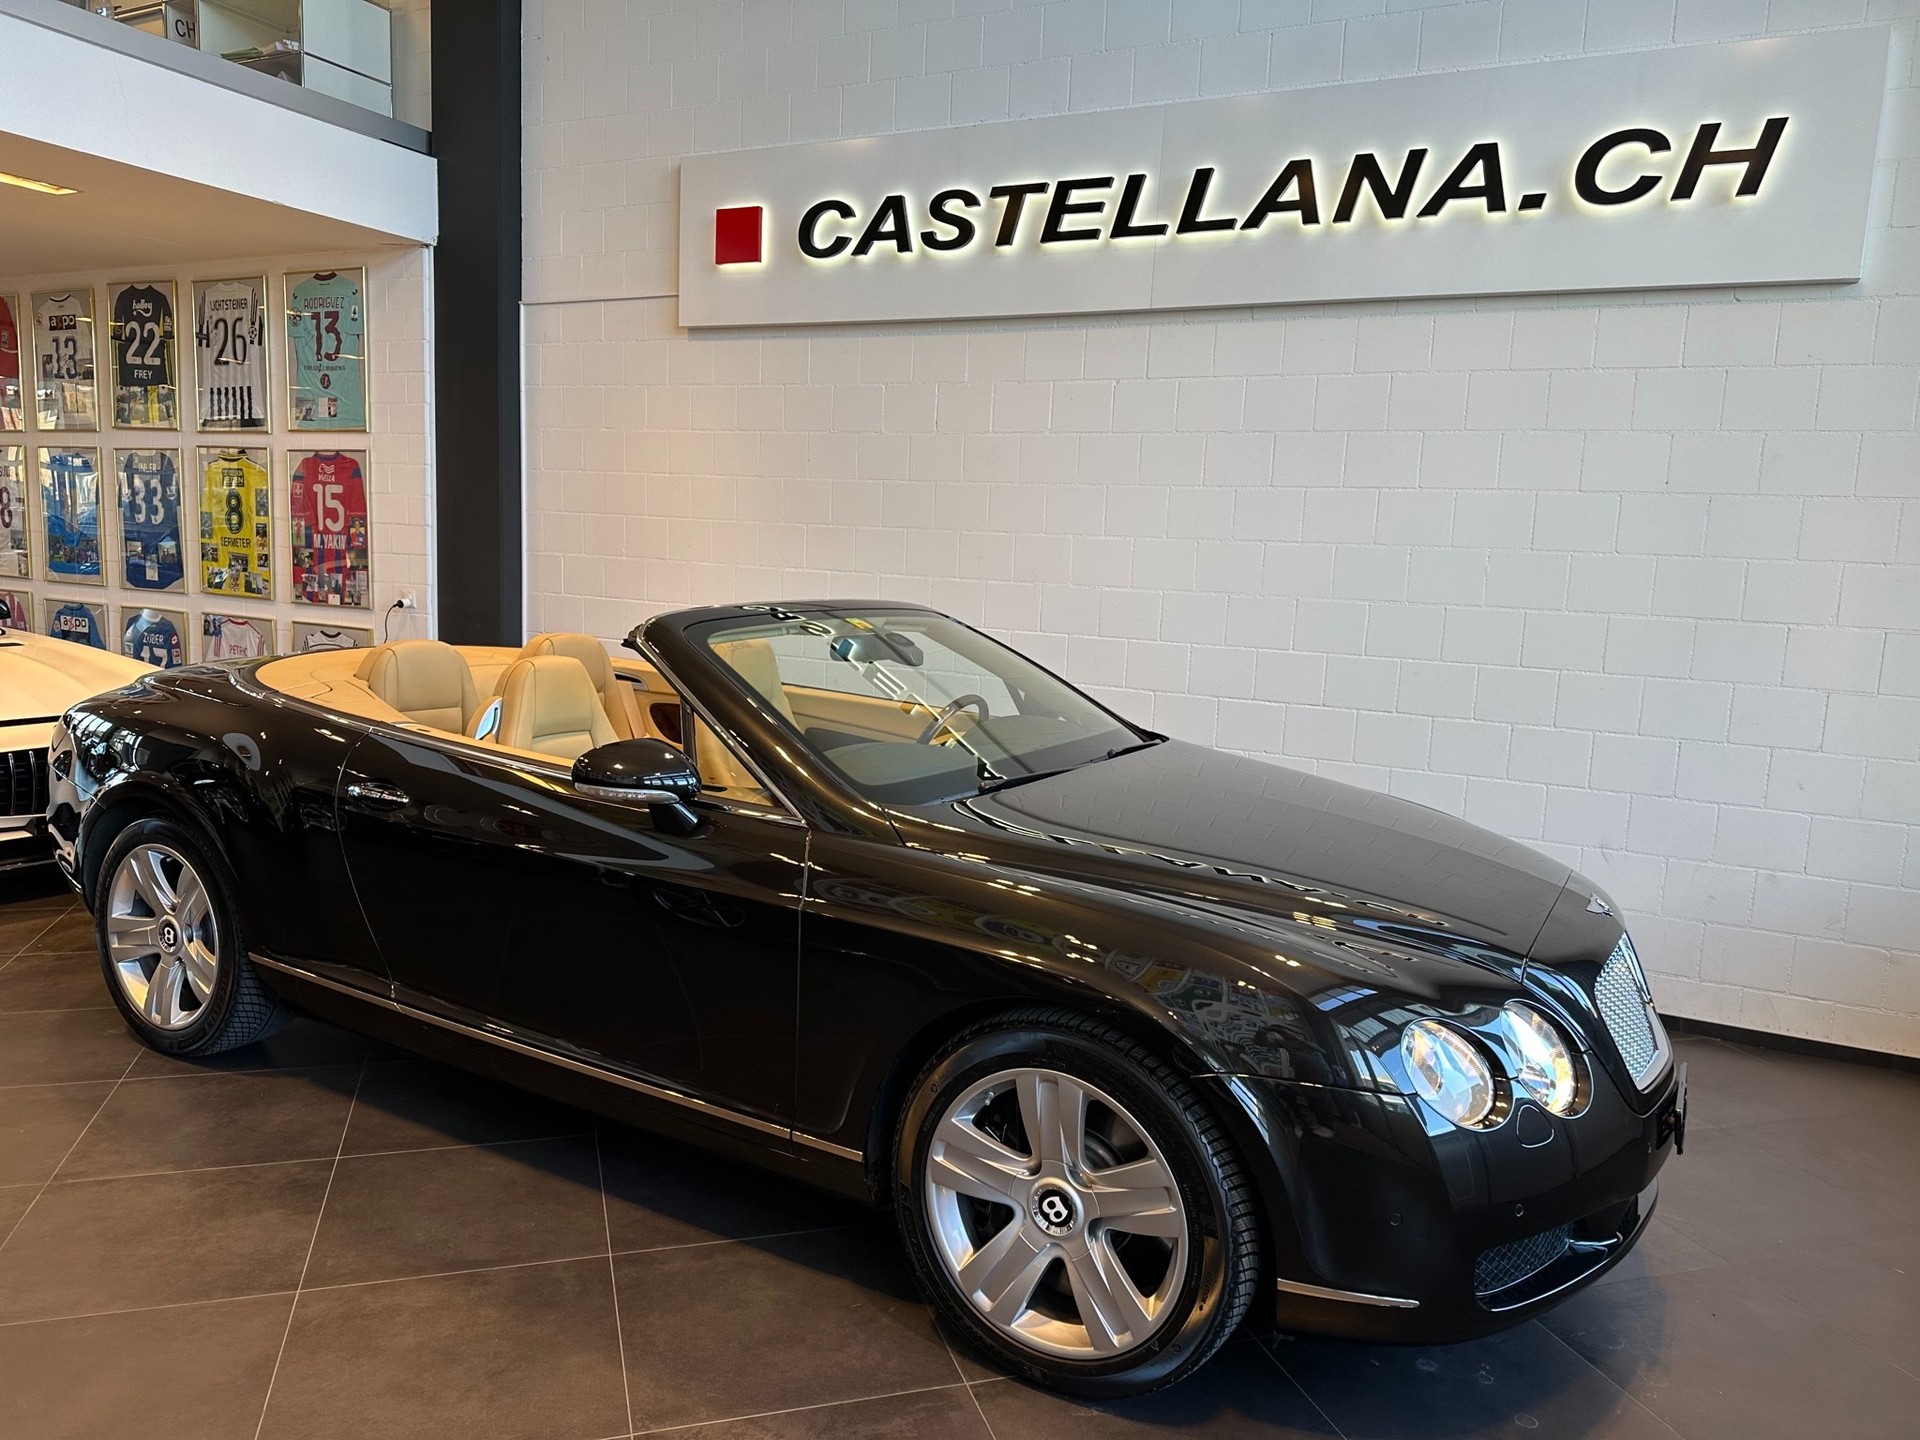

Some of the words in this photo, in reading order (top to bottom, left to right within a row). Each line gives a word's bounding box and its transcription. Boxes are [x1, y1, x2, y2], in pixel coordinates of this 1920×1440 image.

[797, 116, 1788, 260] CASTELLANA.CH
[303, 296, 345, 310] RODRIGUEZ
[125, 321, 161, 365] 22
[214, 318, 247, 366] 26
[310, 311, 342, 362] 13
[133, 369, 153, 380] FREY
[133, 475, 165, 525] 33
[225, 488, 245, 535] 8
[312, 484, 345, 532] 15
[142, 632, 165, 645] ZUBER
